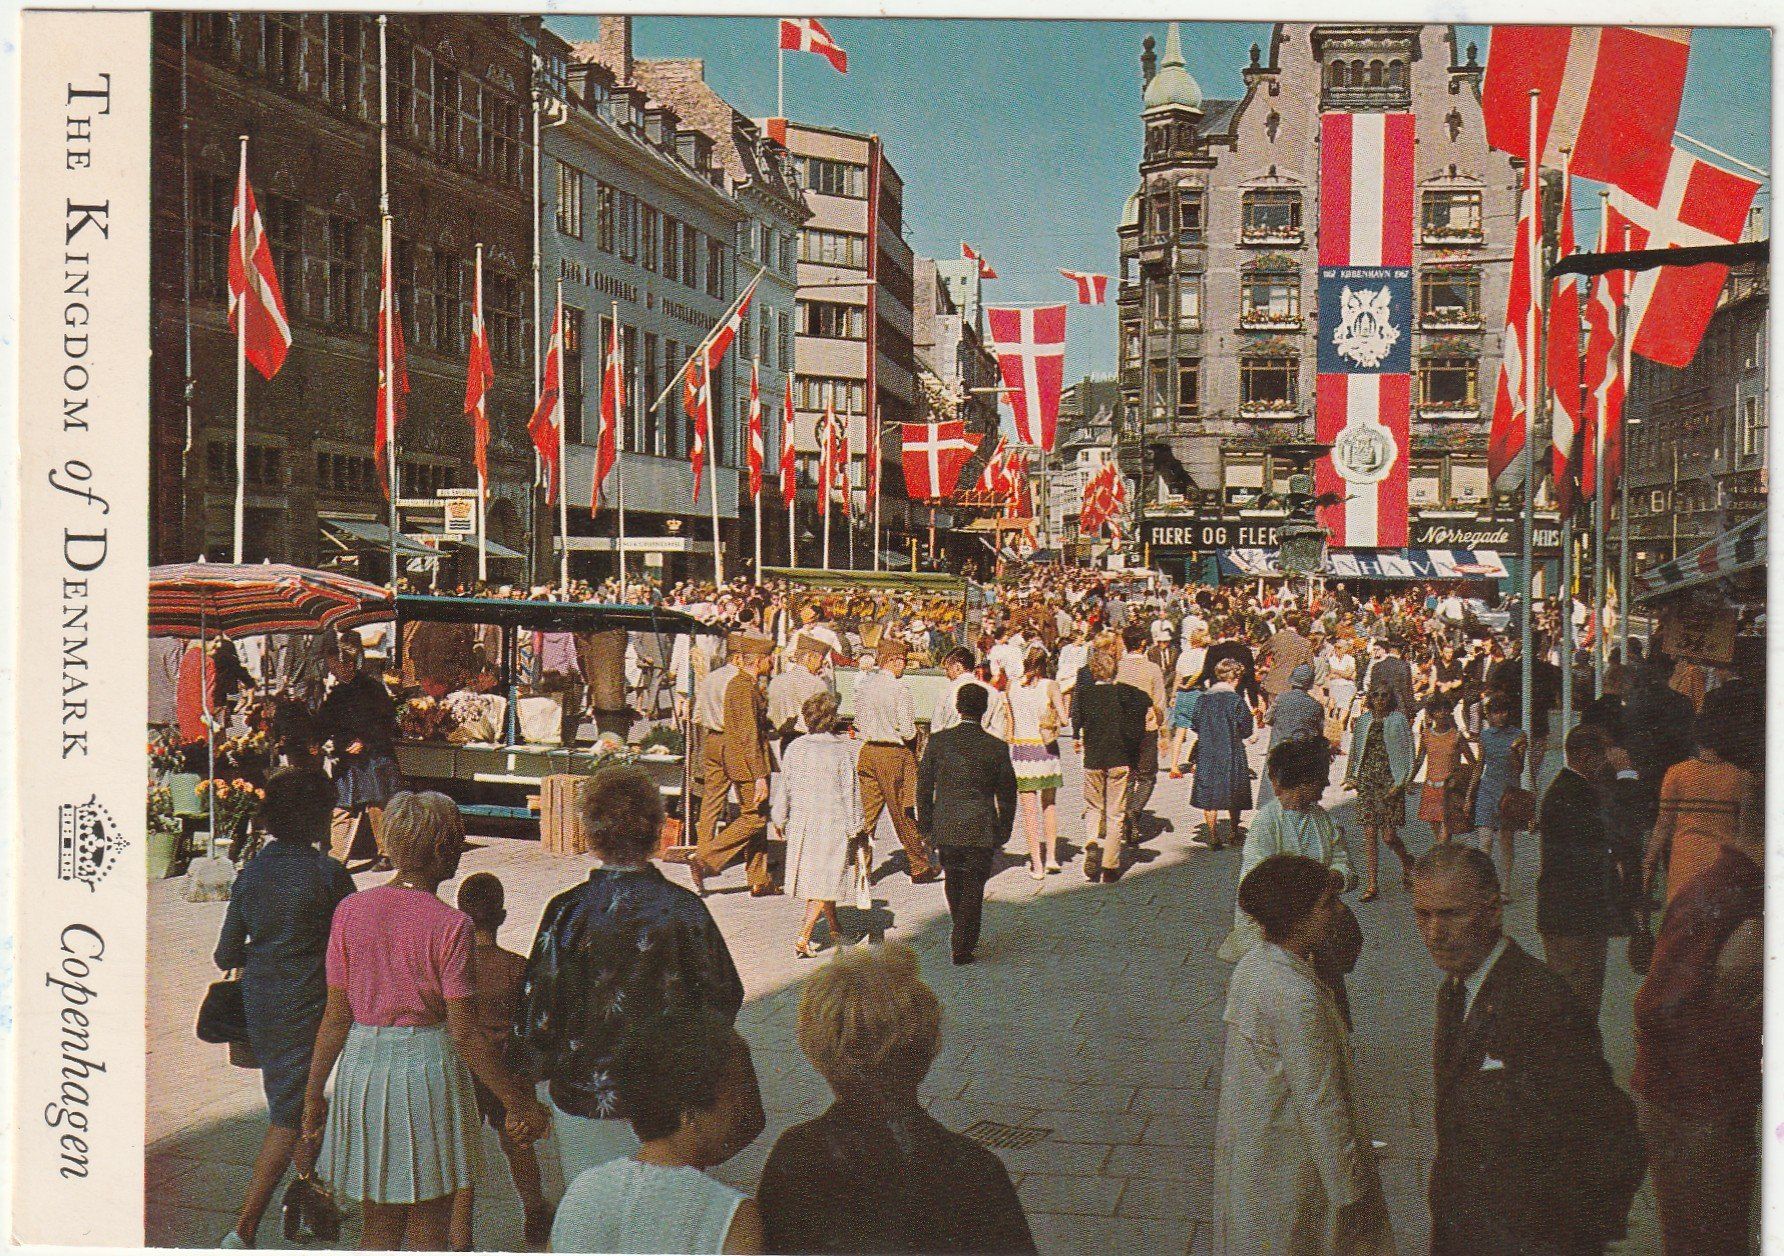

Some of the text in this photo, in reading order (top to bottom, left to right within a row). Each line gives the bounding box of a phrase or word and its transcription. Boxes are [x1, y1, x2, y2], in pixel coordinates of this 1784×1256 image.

[1151, 526, 1279, 546] FLERE OG FLER
[1416, 525, 1510, 550] Nørregade
